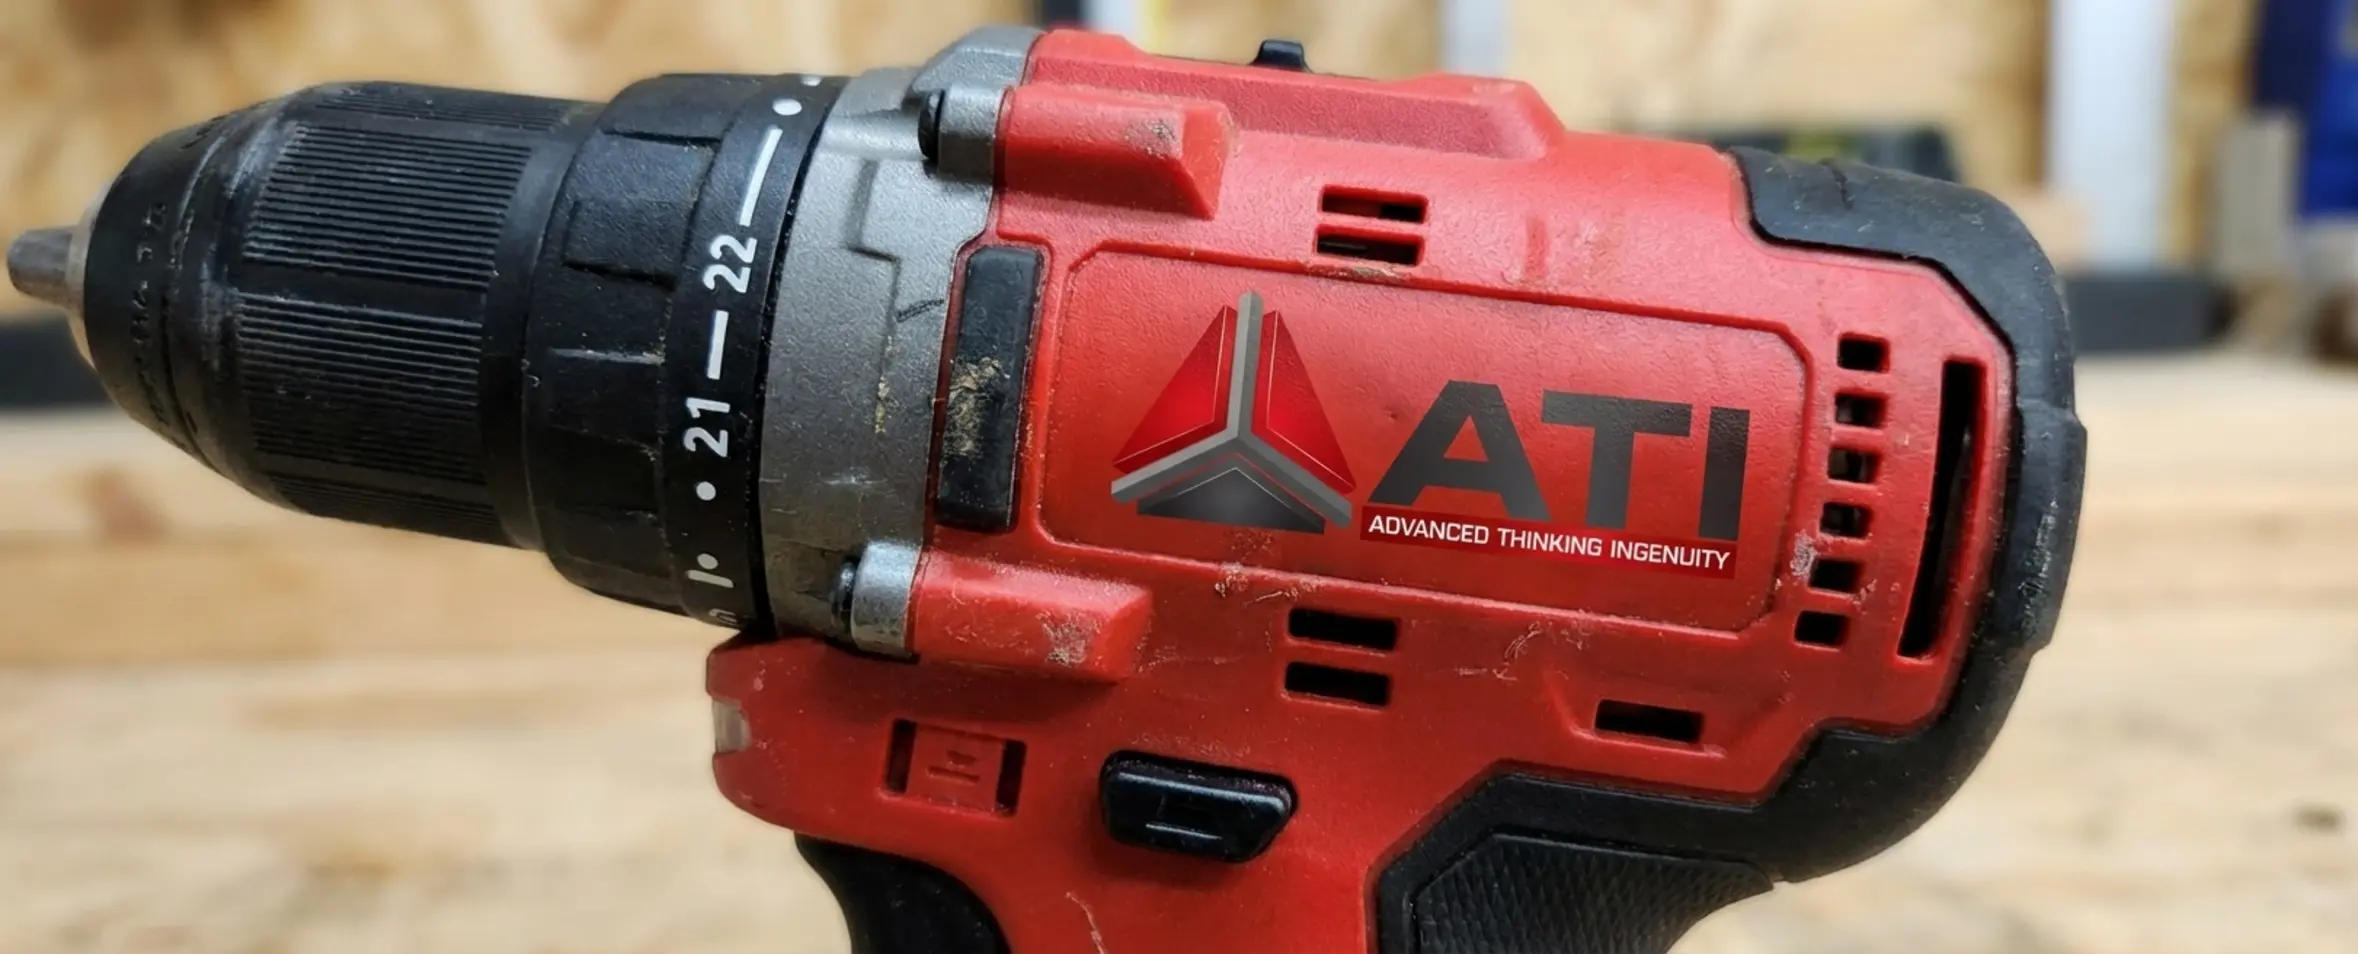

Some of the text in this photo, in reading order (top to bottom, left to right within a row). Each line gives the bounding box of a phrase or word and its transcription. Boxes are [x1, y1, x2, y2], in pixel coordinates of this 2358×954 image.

[702, 233, 757, 294] 22
[684, 397, 731, 458] 21
[1368, 380, 1750, 542] ATI
[1368, 515, 1730, 570] ADVANCED THINKING INGENUITY
